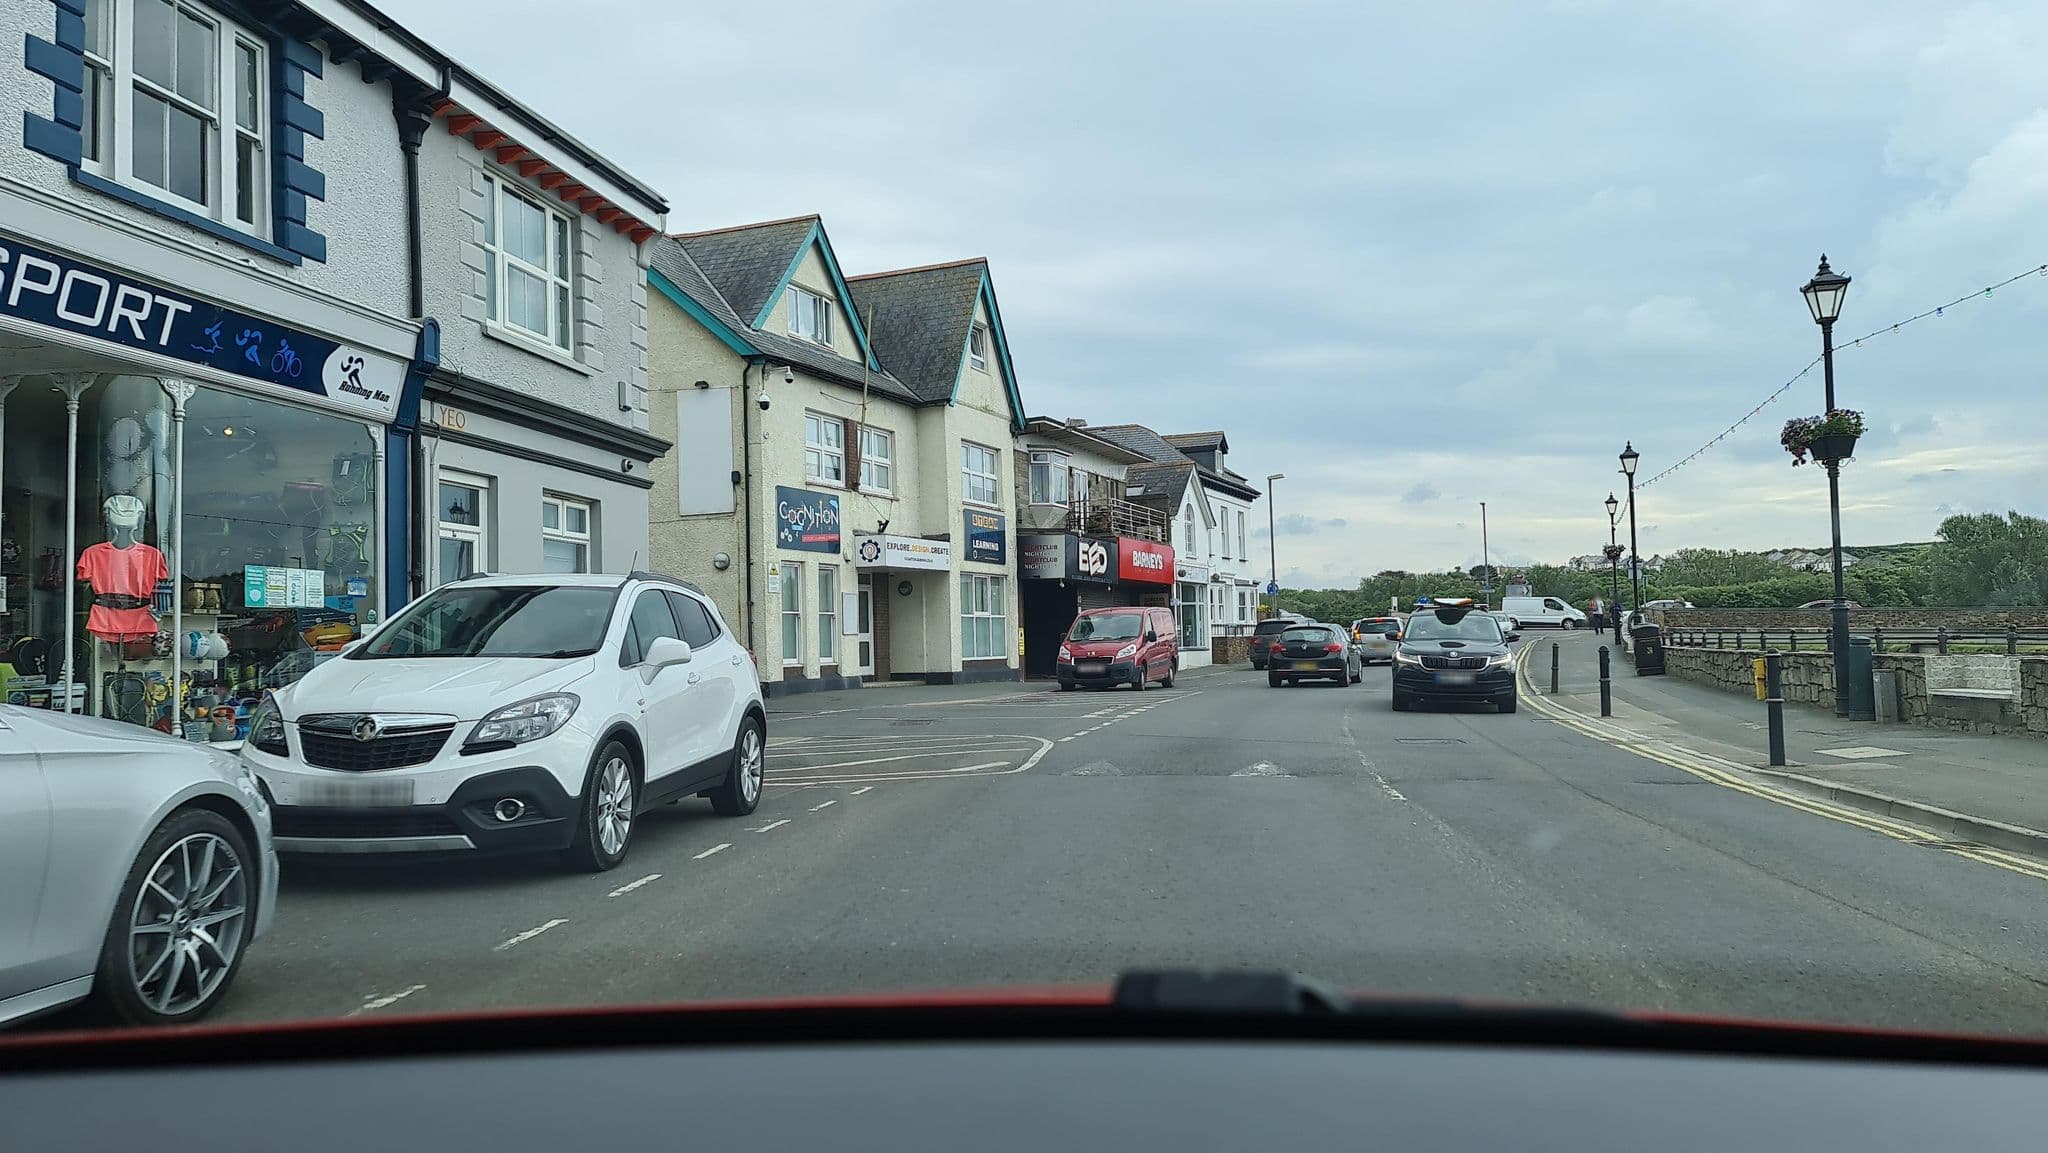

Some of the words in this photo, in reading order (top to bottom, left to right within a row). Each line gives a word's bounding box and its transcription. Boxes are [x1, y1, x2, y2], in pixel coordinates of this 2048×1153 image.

[0, 247, 193, 346] PORT
[339, 381, 374, 400] Running
[373, 388, 391, 403] Man
[440, 405, 466, 429] YEO
[973, 539, 999, 551] LEARNING
[1132, 550, 1163, 570] BARNEY'S
